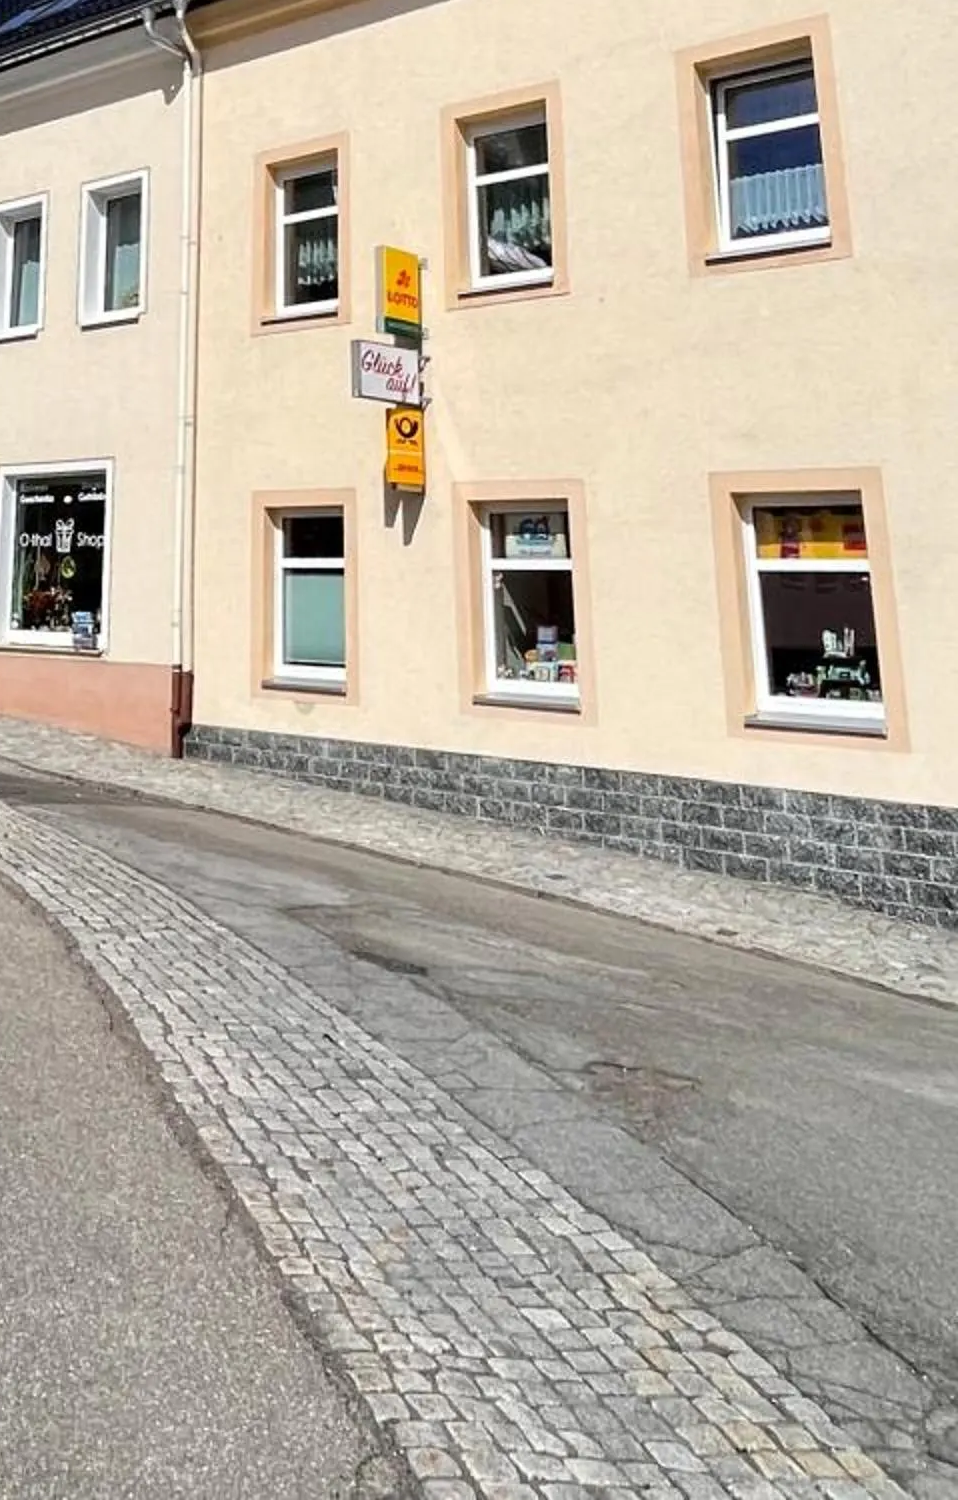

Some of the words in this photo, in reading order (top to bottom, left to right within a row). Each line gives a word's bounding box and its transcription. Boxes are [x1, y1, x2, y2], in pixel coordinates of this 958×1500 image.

[386, 290, 419, 309] LOTTO
[361, 349, 403, 377] Glück
[385, 372, 417, 393] auf!
[19, 532, 53, 547] O-thal
[76, 531, 106, 549] Shop
